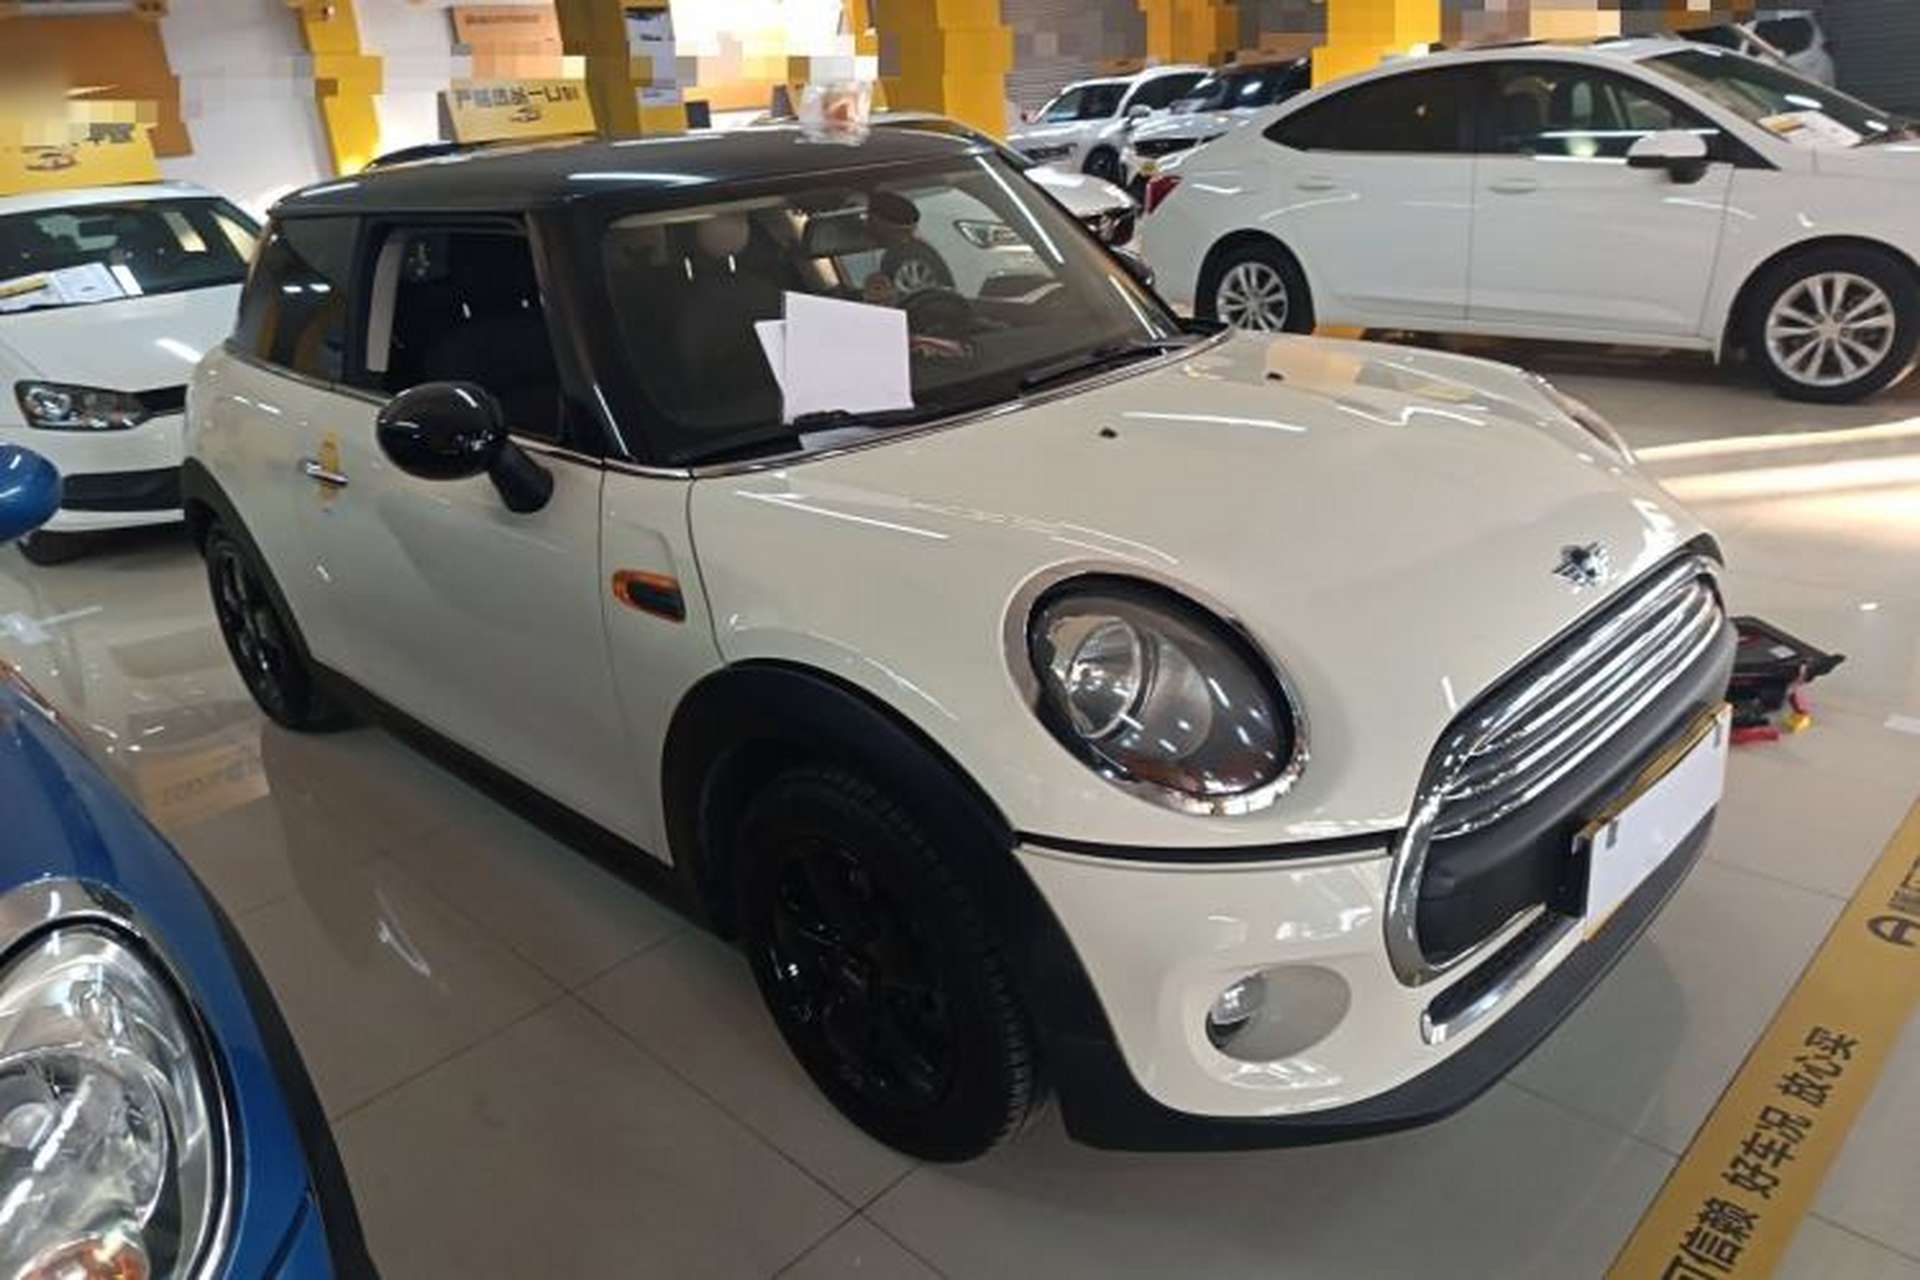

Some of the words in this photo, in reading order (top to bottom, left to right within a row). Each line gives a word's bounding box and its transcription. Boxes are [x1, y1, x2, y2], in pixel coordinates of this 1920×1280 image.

[1720, 1105, 1812, 1200] 好车况
[1774, 1026, 1859, 1108] 放心买
